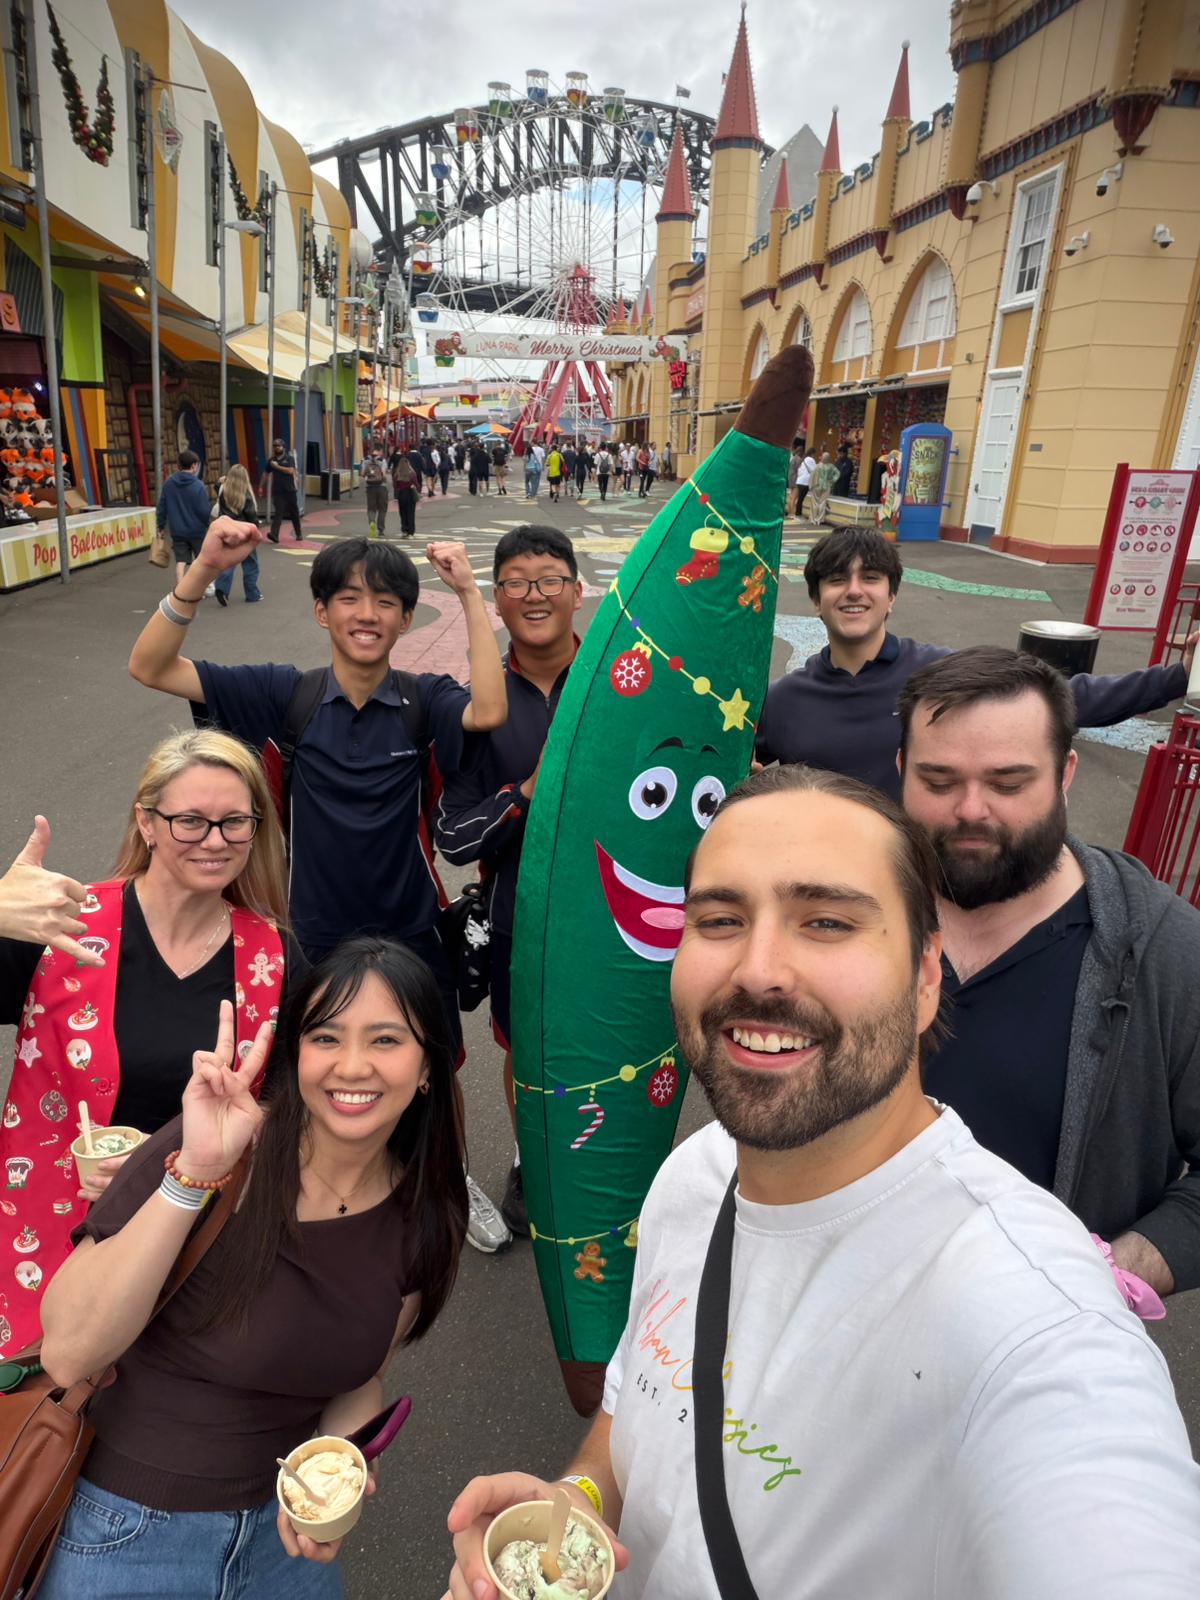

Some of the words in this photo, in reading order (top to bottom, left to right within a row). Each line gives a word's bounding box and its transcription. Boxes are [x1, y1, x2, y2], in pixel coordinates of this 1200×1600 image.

[476, 341, 498, 352] LUNA
[499, 341, 520, 354] PARK
[530, 340, 574, 360] Merry
[579, 340, 643, 357] Christmas
[33, 543, 57, 567] Pop
[70, 530, 115, 559] Balloon
[116, 524, 126, 542] to
[128, 520, 145, 541] win!
[636, 1372, 662, 1406] EST.
